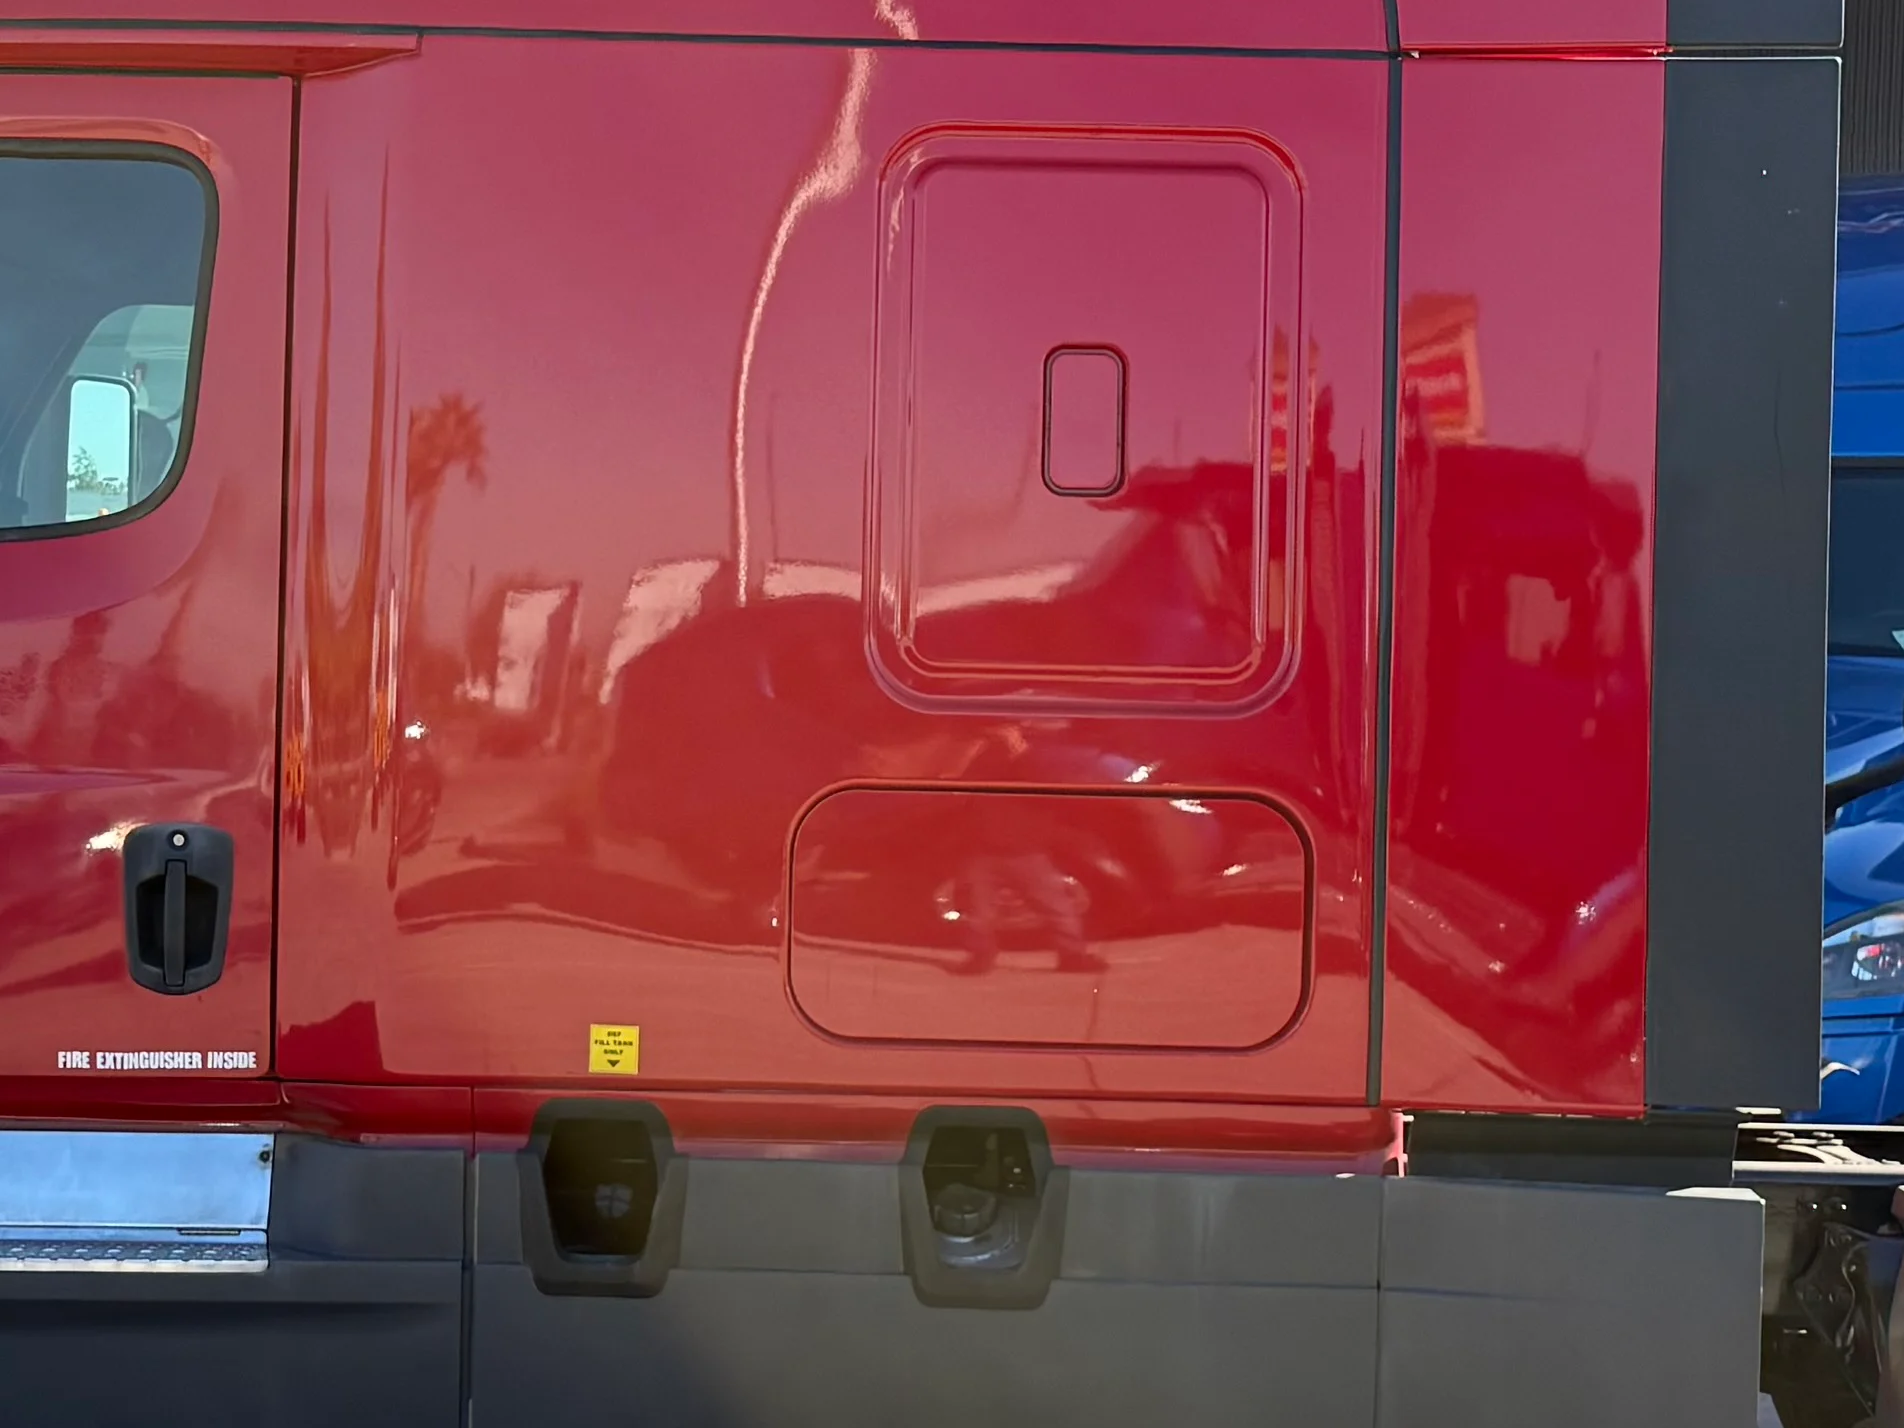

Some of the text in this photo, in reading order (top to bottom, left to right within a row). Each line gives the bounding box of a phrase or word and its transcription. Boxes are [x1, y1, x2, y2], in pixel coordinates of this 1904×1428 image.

[57, 1051, 257, 1070] FIRE EXTINGUISHER INSIDE
